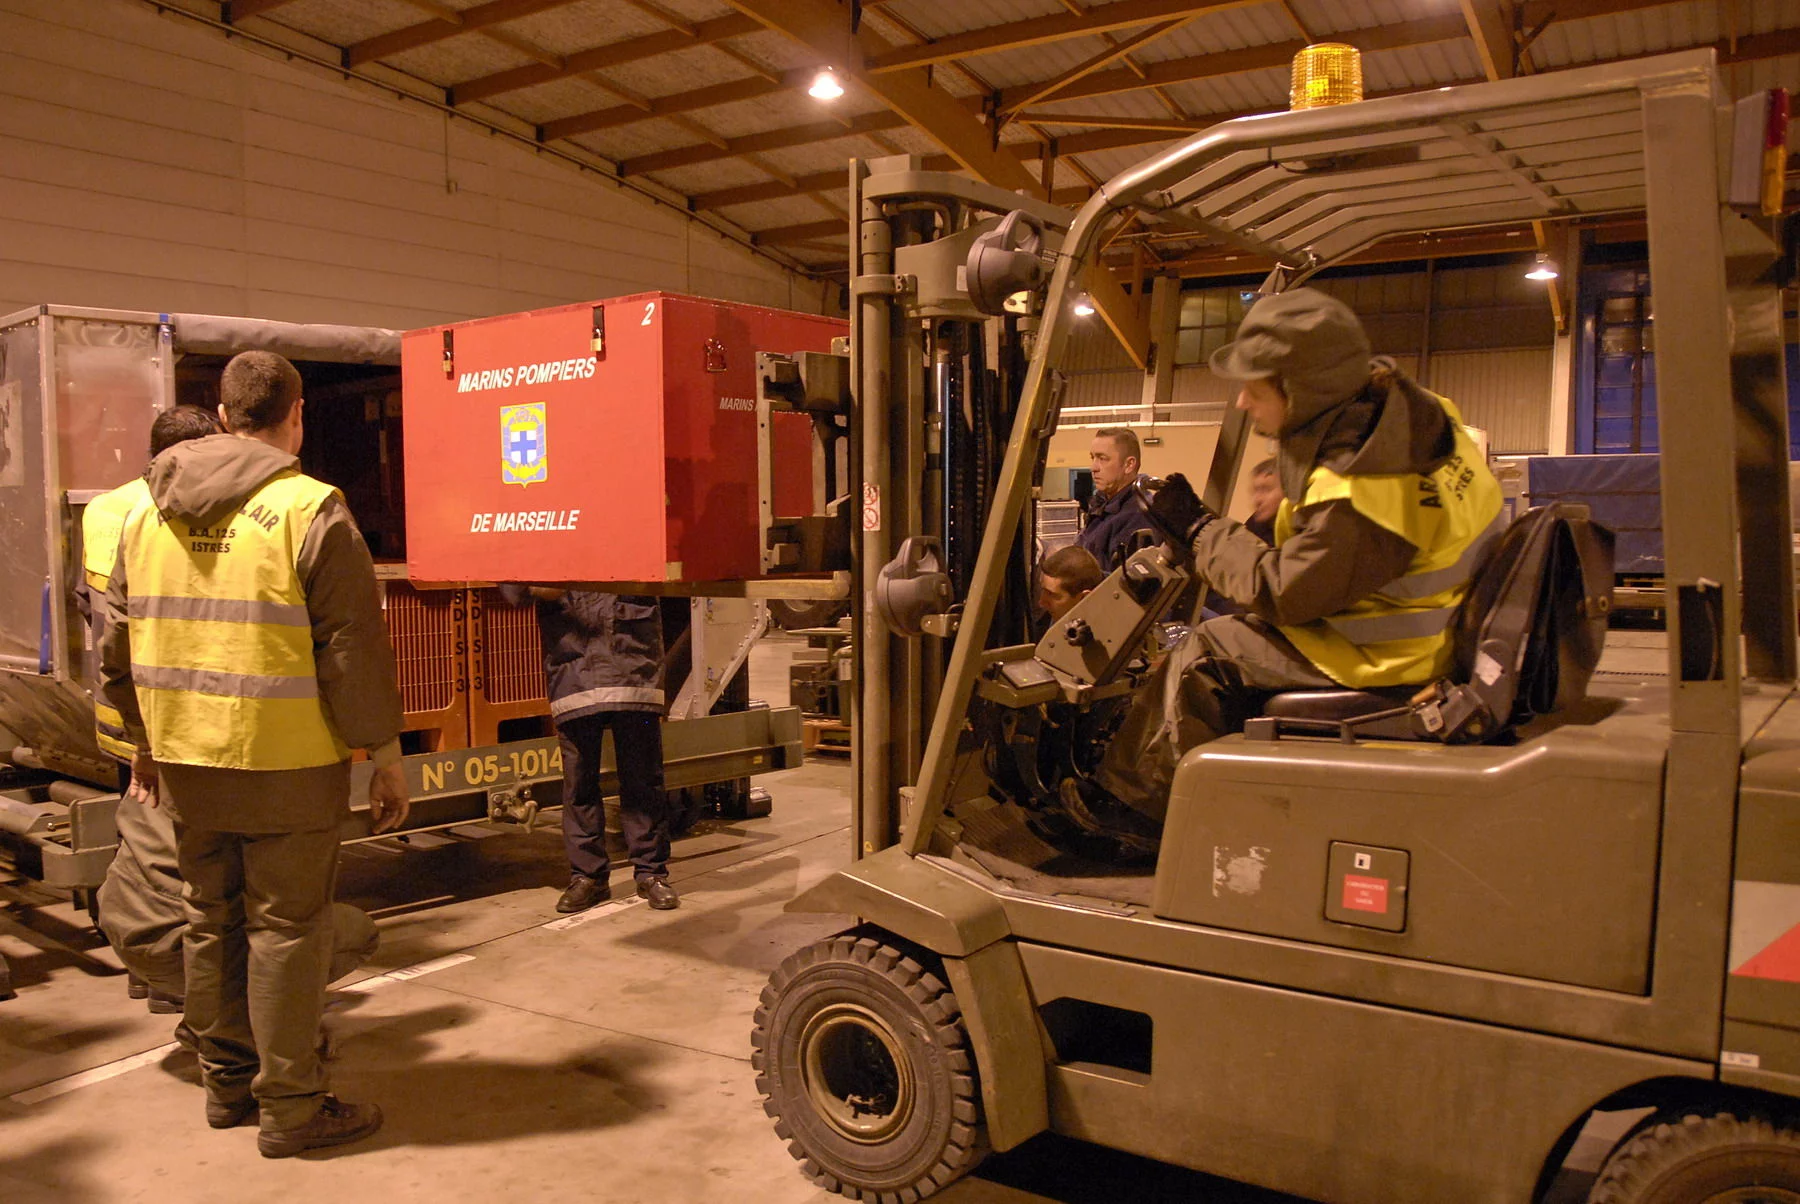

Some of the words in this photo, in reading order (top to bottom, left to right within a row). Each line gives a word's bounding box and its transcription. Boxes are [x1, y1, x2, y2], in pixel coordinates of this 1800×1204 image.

[641, 302, 655, 326] 2
[457, 367, 515, 393] MARINS
[515, 356, 597, 386] POMPIERS
[719, 397, 754, 412] MARINS
[470, 513, 492, 532] DE
[493, 509, 580, 532] MARSEILLE
[191, 541, 231, 553] ISTRES
[453, 591, 464, 655] SDIS
[471, 589, 482, 653] SDIS
[456, 662, 465, 692] 13
[474, 660, 483, 690] 13
[464, 745, 564, 785] 05-1014
